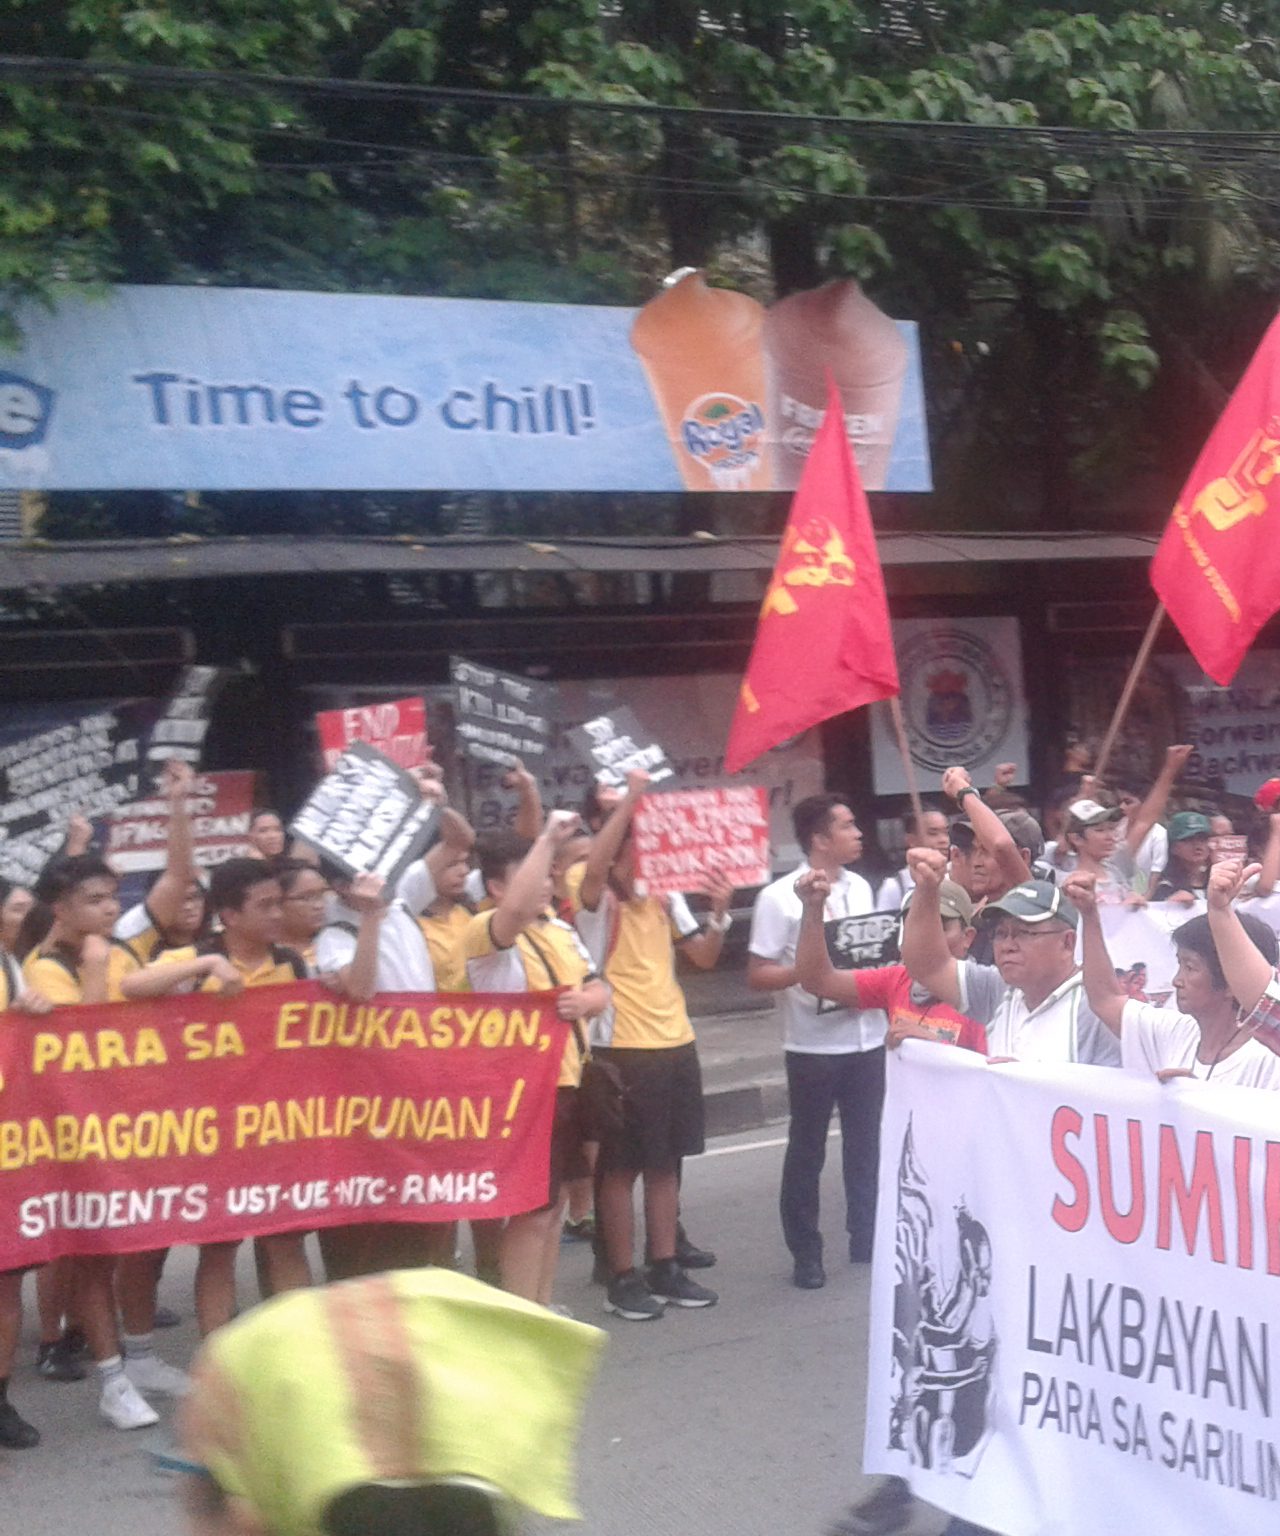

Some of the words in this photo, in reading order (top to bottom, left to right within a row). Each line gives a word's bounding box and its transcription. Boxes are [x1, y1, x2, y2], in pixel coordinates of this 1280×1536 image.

[134, 373, 323, 427] Time
[344, 379, 419, 428] to
[440, 381, 596, 436] chill!
[681, 401, 765, 456] Royal
[836, 915, 900, 951] STOP
[33, 1028, 167, 1074] PARA
[184, 1022, 245, 1060] SA
[276, 1002, 551, 1052] EDUKASYON,
[19, 1184, 208, 1238] STUDENTS
[1026, 1264, 1271, 1418] LAKBAYAN
[1018, 1371, 1105, 1444] PARA
[1112, 1396, 1152, 1462] SA
